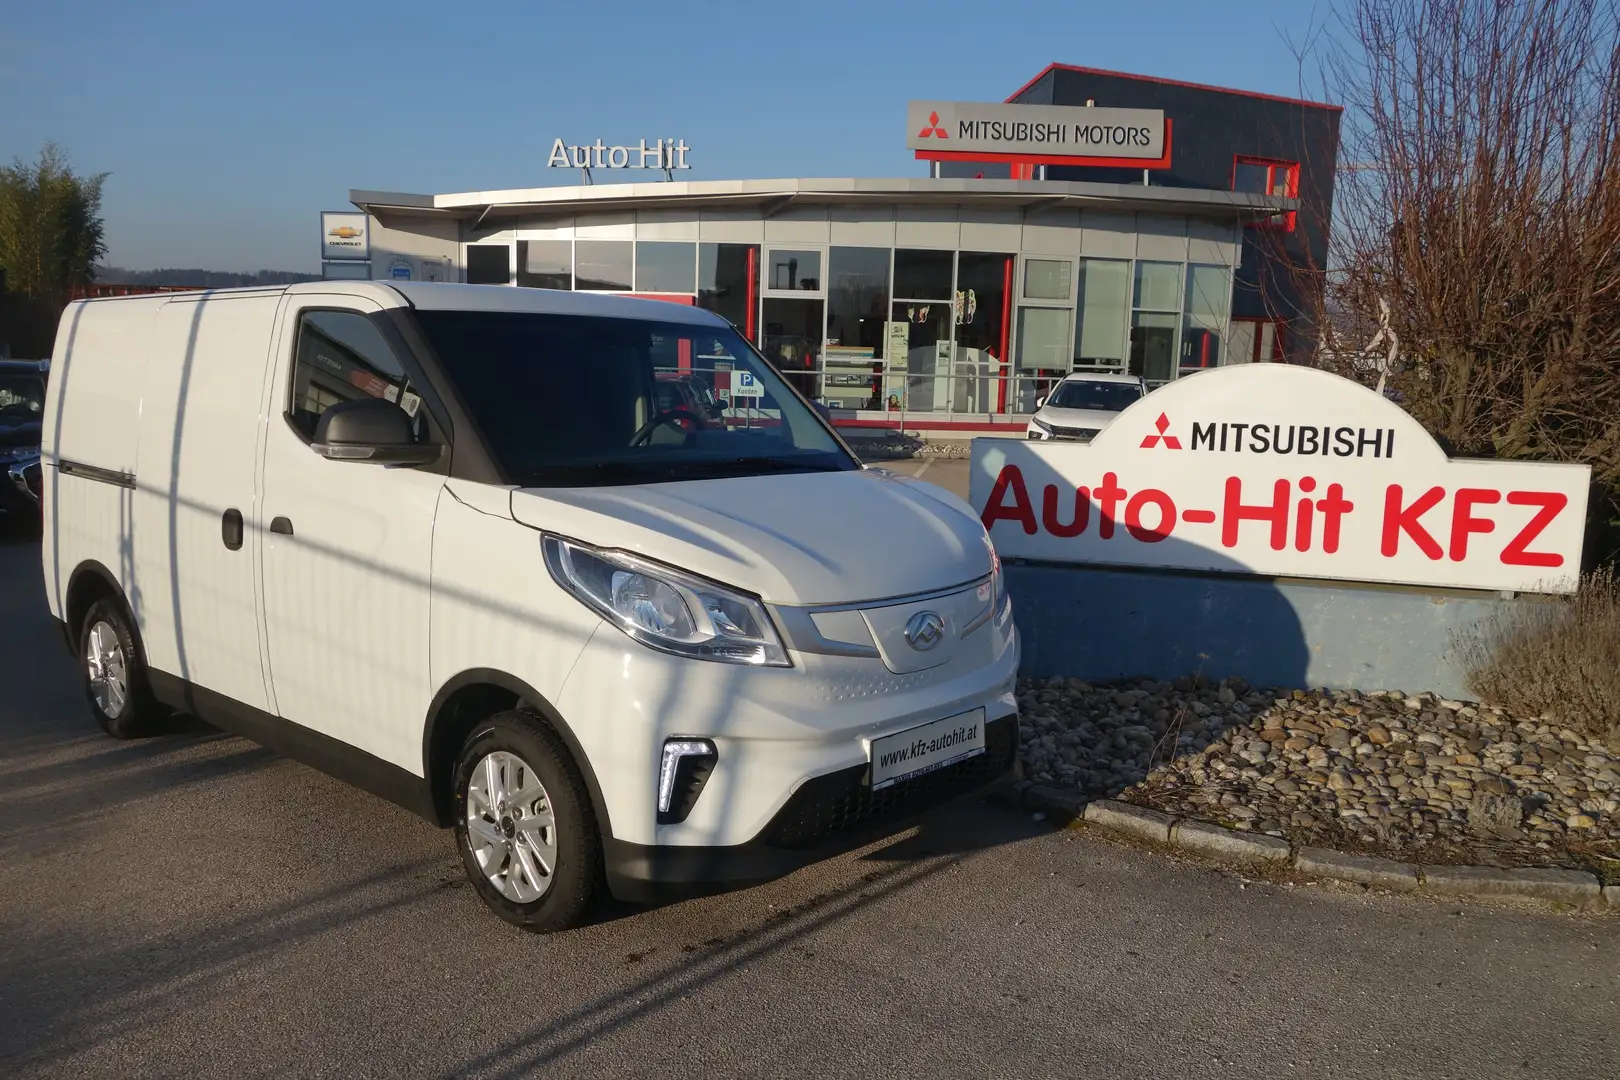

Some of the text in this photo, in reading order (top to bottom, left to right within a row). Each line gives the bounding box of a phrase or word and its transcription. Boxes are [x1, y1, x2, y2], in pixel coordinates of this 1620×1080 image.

[959, 120, 1150, 146] MITSUBISHI MOTORS
[547, 138, 691, 169] Auto Hit
[743, 374, 752, 386] P
[1191, 421, 1395, 458] MITSUBISHI
[980, 464, 1568, 567] Auto-Hit KFZ
[880, 724, 977, 768] www.kfz-autohit.at
